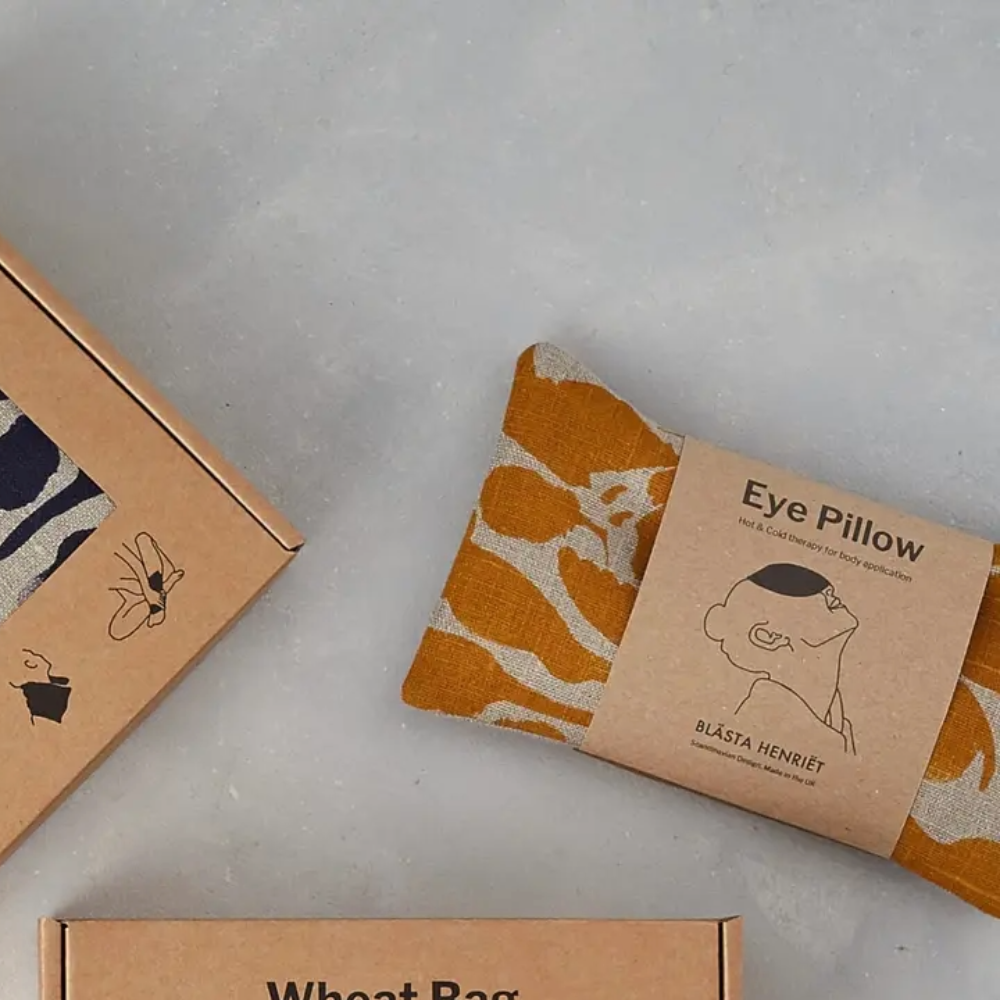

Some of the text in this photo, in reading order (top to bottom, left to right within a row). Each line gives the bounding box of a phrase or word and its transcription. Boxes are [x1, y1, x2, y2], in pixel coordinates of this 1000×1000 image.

[738, 516, 912, 582] Hot & Cold therapy for body application
[742, 479, 924, 561] Eye Pillow
[695, 720, 825, 773] BLÄSTA HENRIËT
[763, 765, 782, 776] Made
